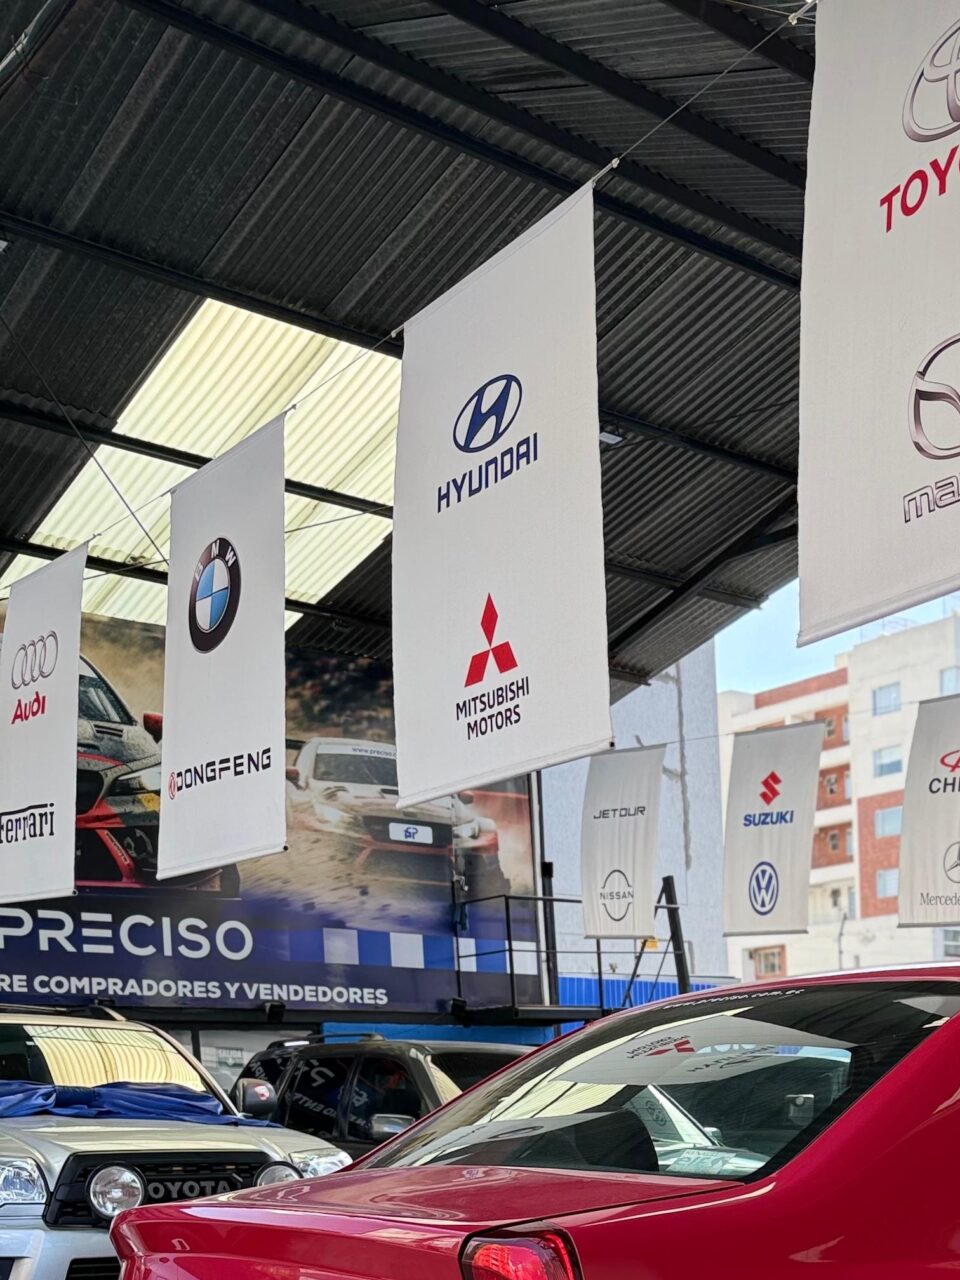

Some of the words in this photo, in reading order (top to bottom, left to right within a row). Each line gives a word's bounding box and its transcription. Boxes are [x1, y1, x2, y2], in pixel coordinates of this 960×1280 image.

[437, 432, 538, 513] HYUNDAI
[11, 691, 46, 725] Audi
[456, 676, 529, 721] MITSUBISHI
[467, 704, 521, 740] MOTORS
[176, 747, 271, 792] DONGFENG
[593, 806, 646, 819] JETOUR
[743, 810, 794, 827] SUZUKI
[600, 890, 634, 900] NISSAN
[0, 907, 253, 960] PRECISO
[33, 975, 221, 1000] COMPRADORES
[220, 982, 240, 998] Y
[240, 983, 388, 1005] VENDEDORES
[147, 1180, 231, 1199] OYOTA
